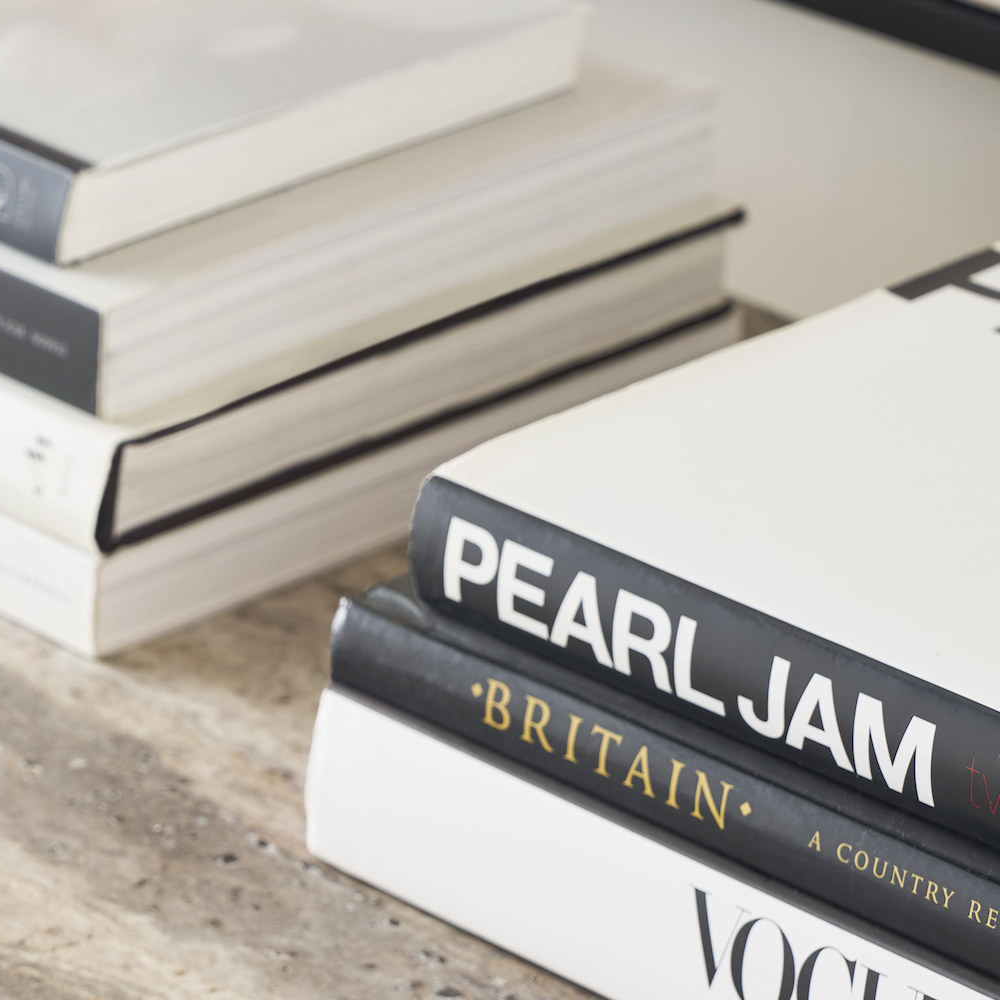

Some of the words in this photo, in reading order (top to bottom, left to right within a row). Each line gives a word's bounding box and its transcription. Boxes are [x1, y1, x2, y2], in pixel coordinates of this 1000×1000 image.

[443, 515, 726, 718] PEARL
[737, 655, 937, 808] JAM
[482, 678, 734, 830] BRITAIN
[807, 830, 821, 852] A
[836, 842, 955, 909] COUNTRY
